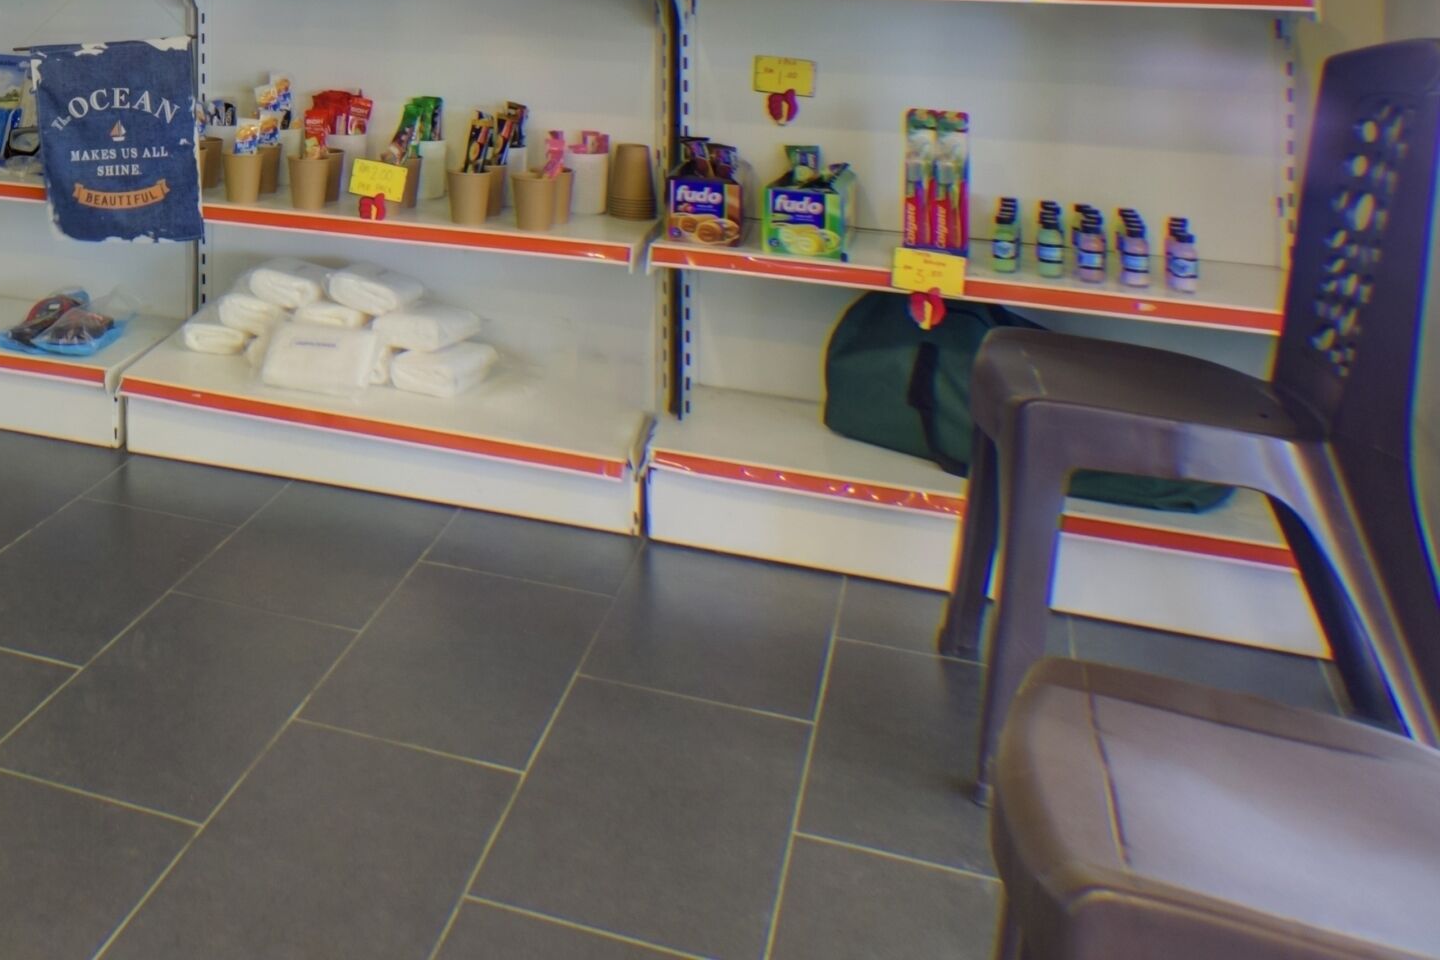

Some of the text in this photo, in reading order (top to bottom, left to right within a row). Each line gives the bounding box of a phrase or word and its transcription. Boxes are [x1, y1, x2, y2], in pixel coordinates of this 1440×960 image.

[68, 87, 180, 124] OCEAN
[70, 146, 169, 162] MAKES US ALL
[85, 191, 158, 207] BEAUTIFUL
[676, 184, 723, 205] fudo
[774, 194, 824, 215] fudo
[905, 202, 918, 246] Colgate
[935, 205, 949, 249] Colgate
